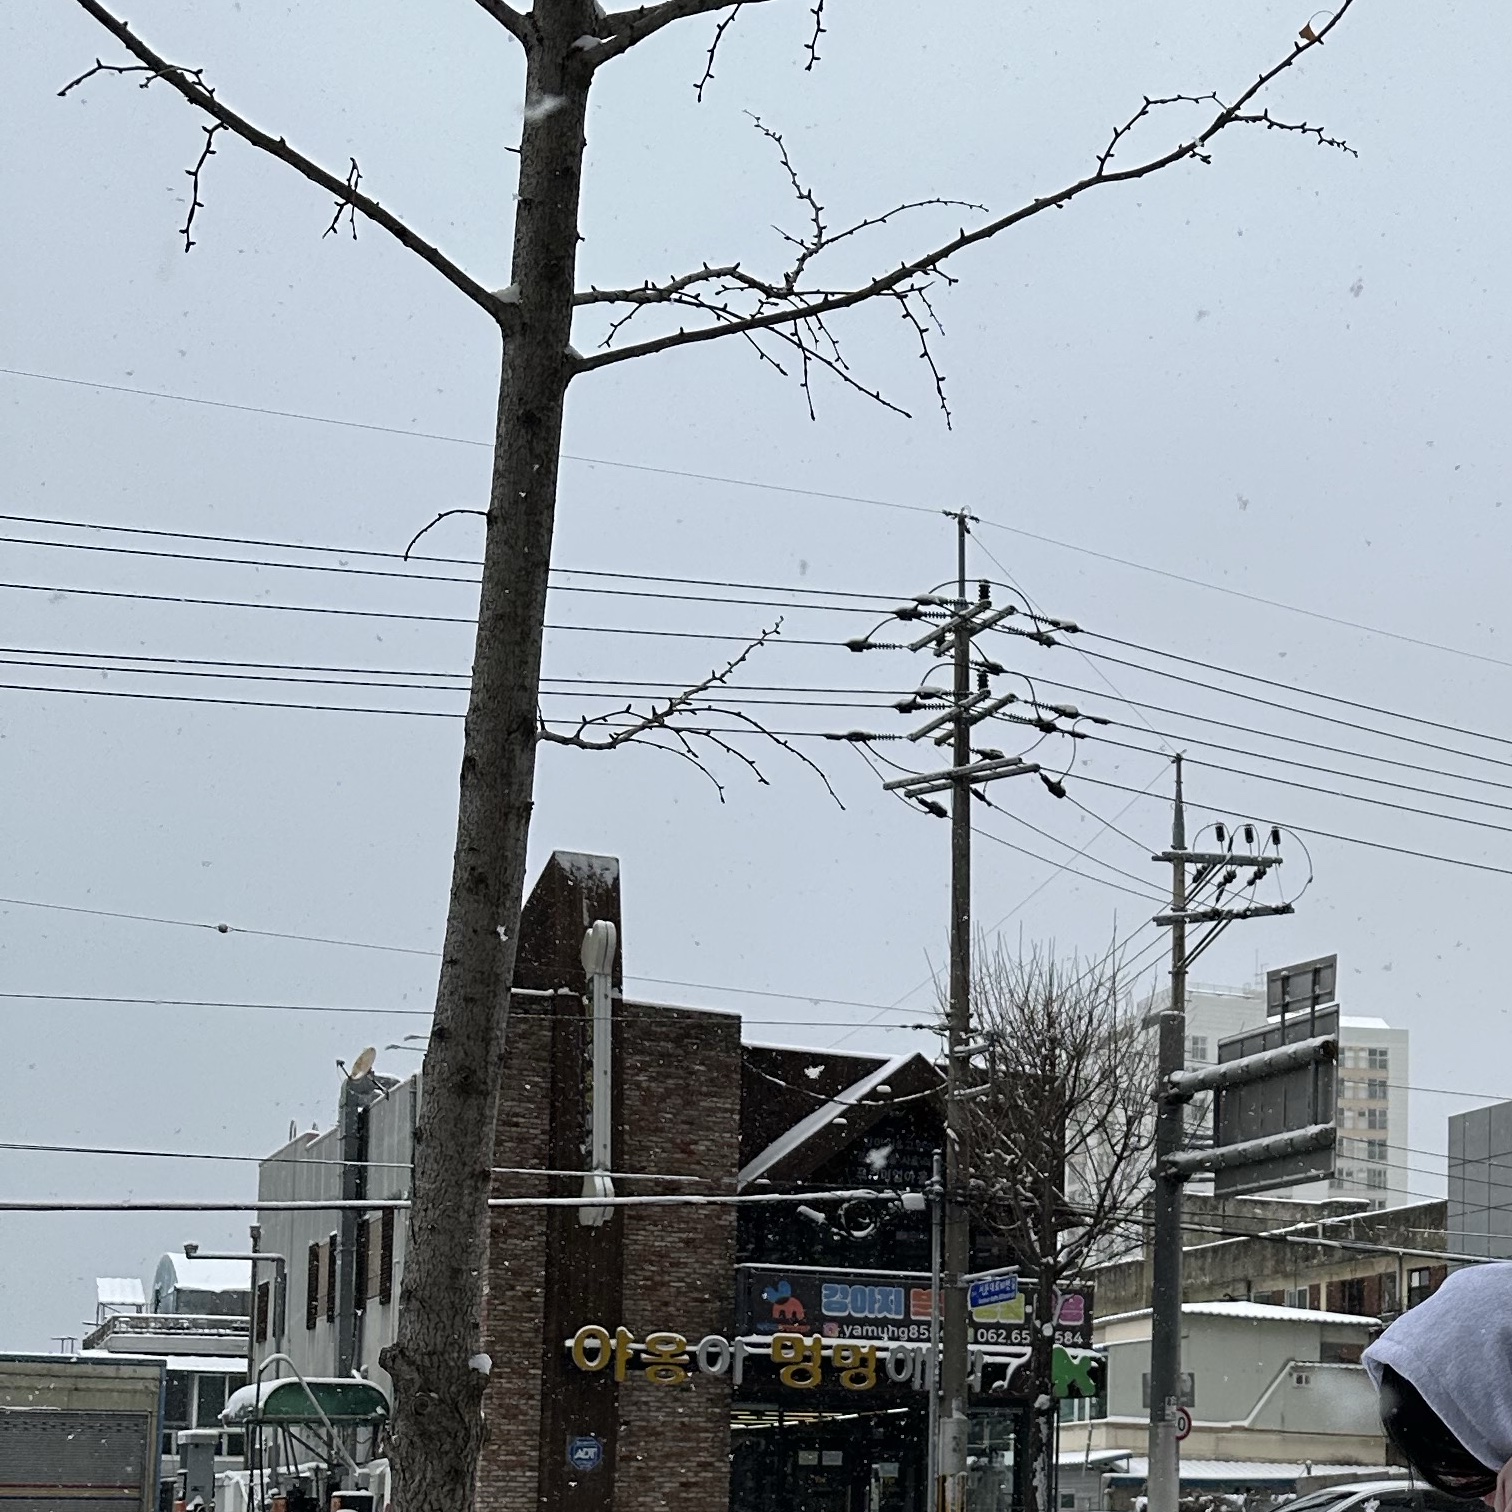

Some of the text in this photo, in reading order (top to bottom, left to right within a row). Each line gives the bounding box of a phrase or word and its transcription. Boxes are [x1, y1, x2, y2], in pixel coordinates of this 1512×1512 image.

[821, 1283, 905, 1321] 강아지
[977, 1328, 1084, 1344] 062.65584
[571, 1325, 750, 1386] 야옹아
[574, 1447, 597, 1460] ADT
